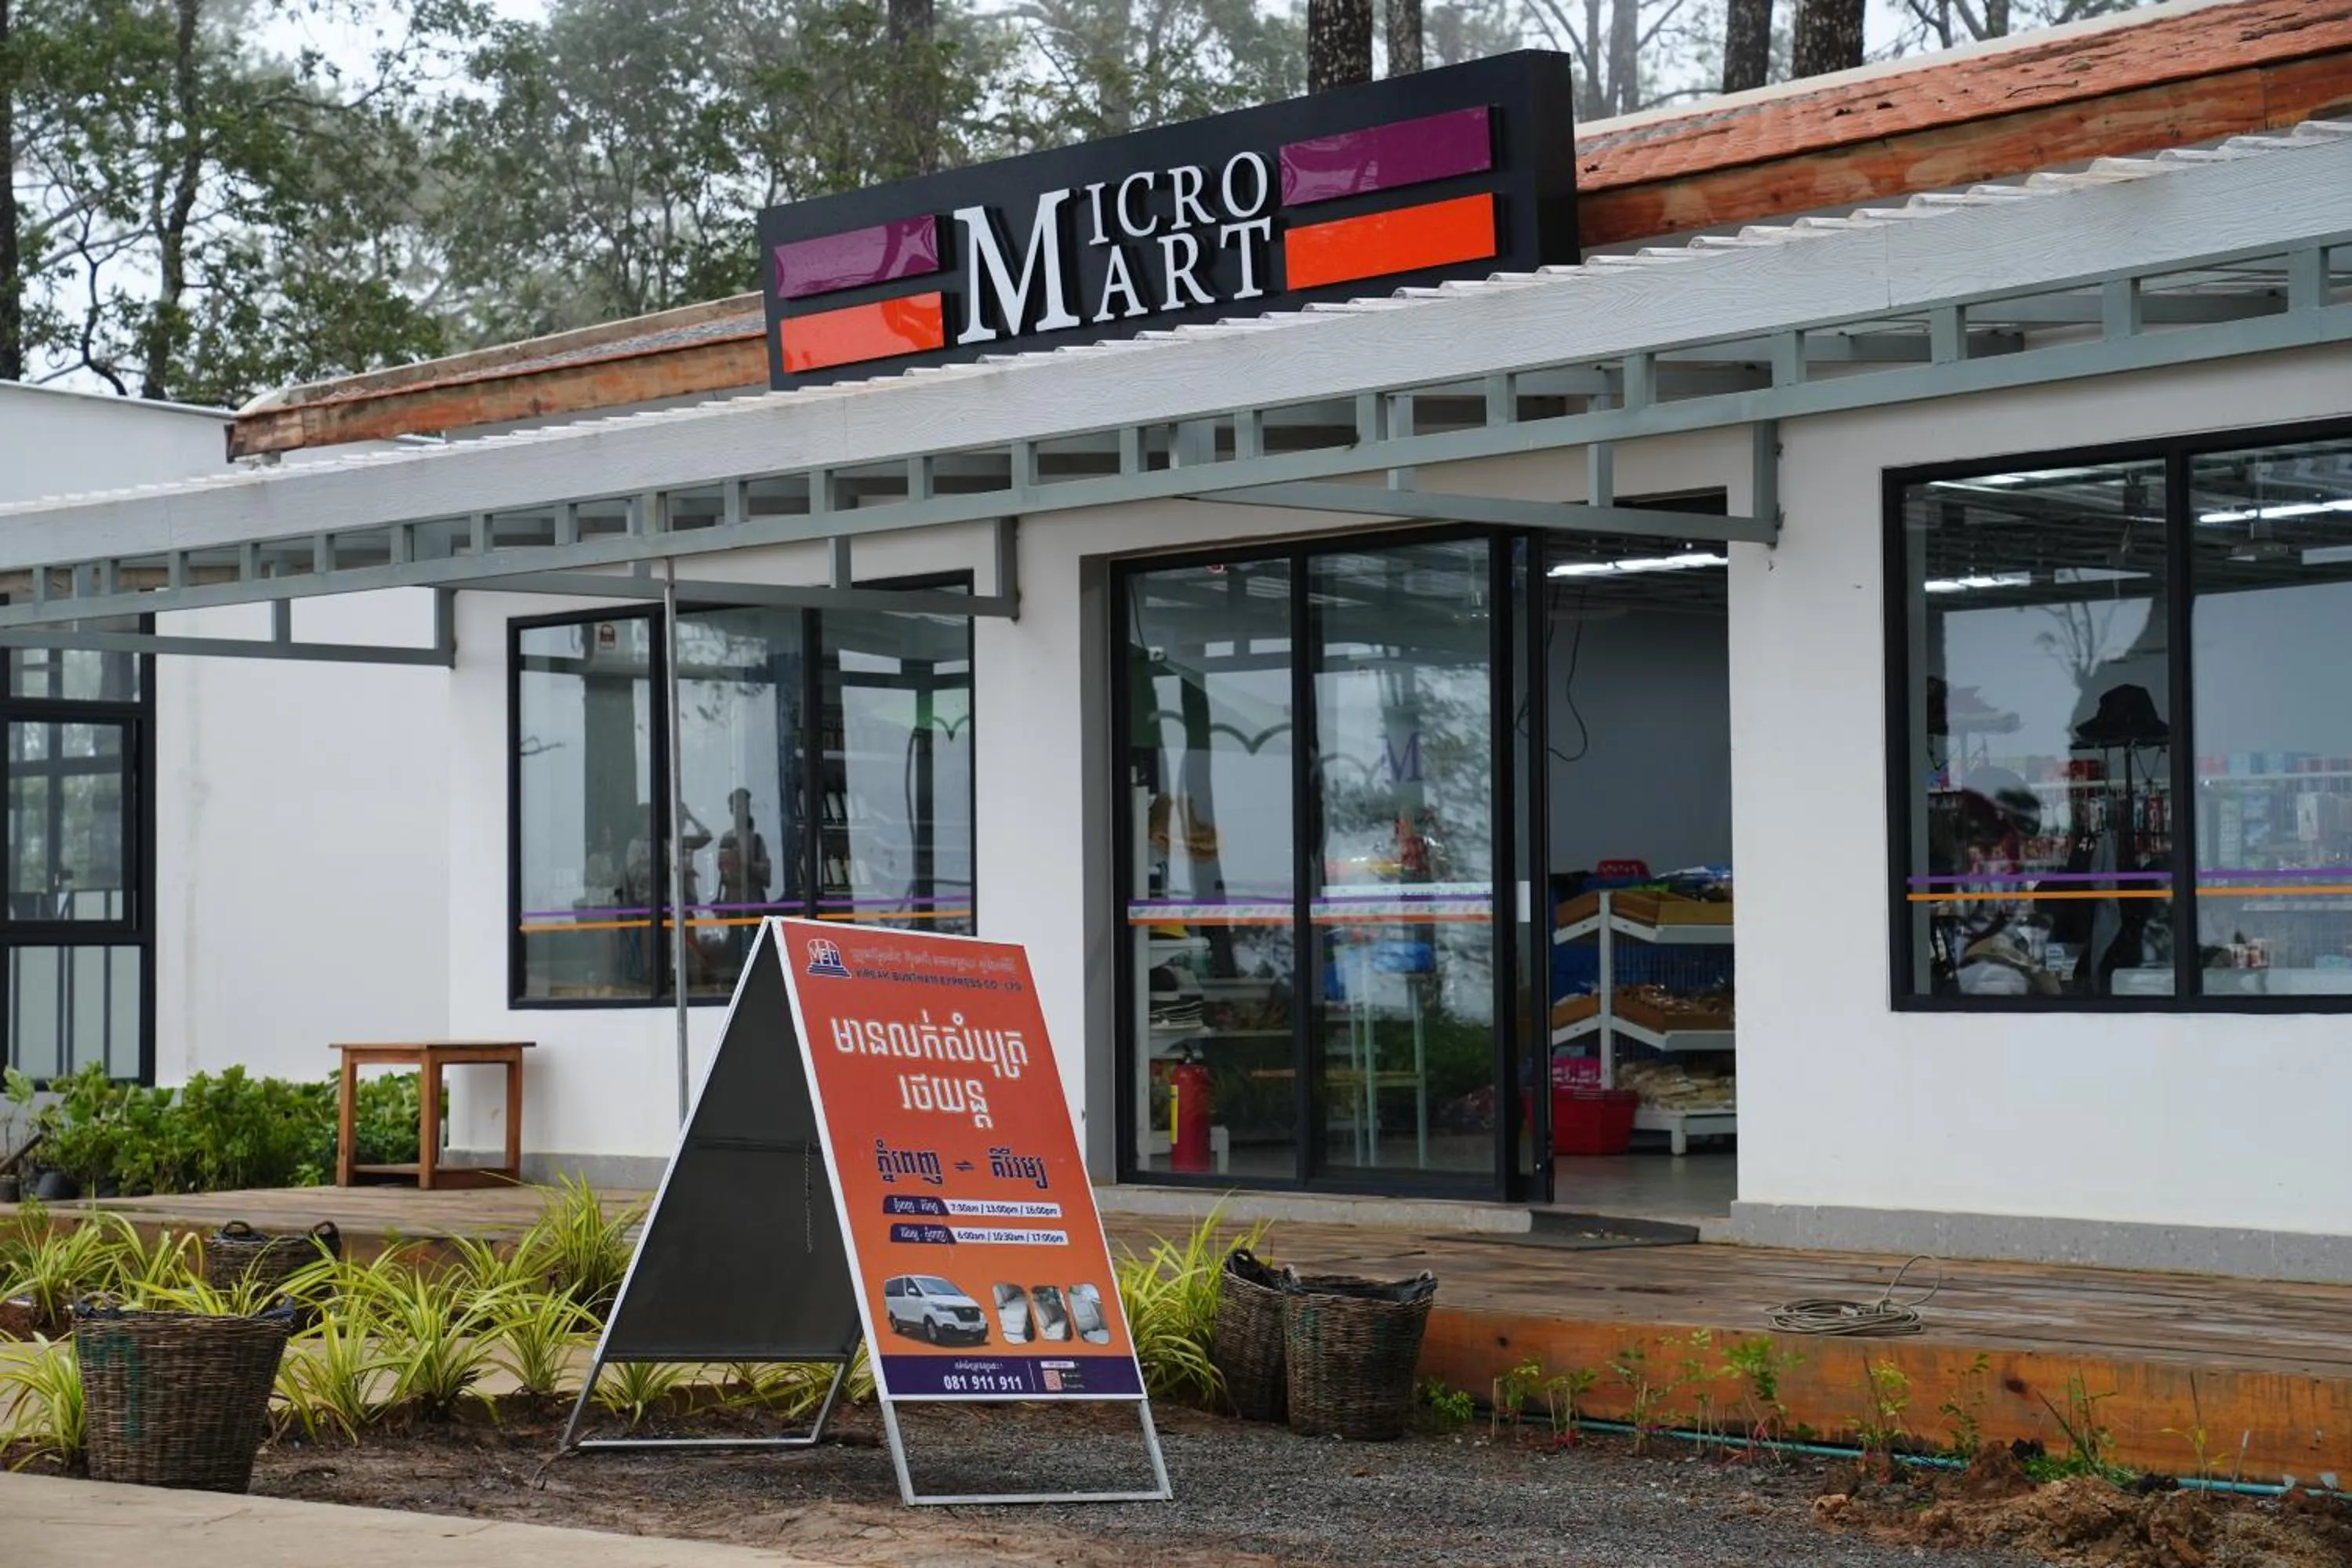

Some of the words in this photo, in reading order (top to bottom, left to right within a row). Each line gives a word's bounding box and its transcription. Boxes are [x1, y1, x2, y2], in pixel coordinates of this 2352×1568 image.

[943, 1375, 967, 1390] 081
[972, 1375, 995, 1390] 911
[999, 1376, 1022, 1390] 911
